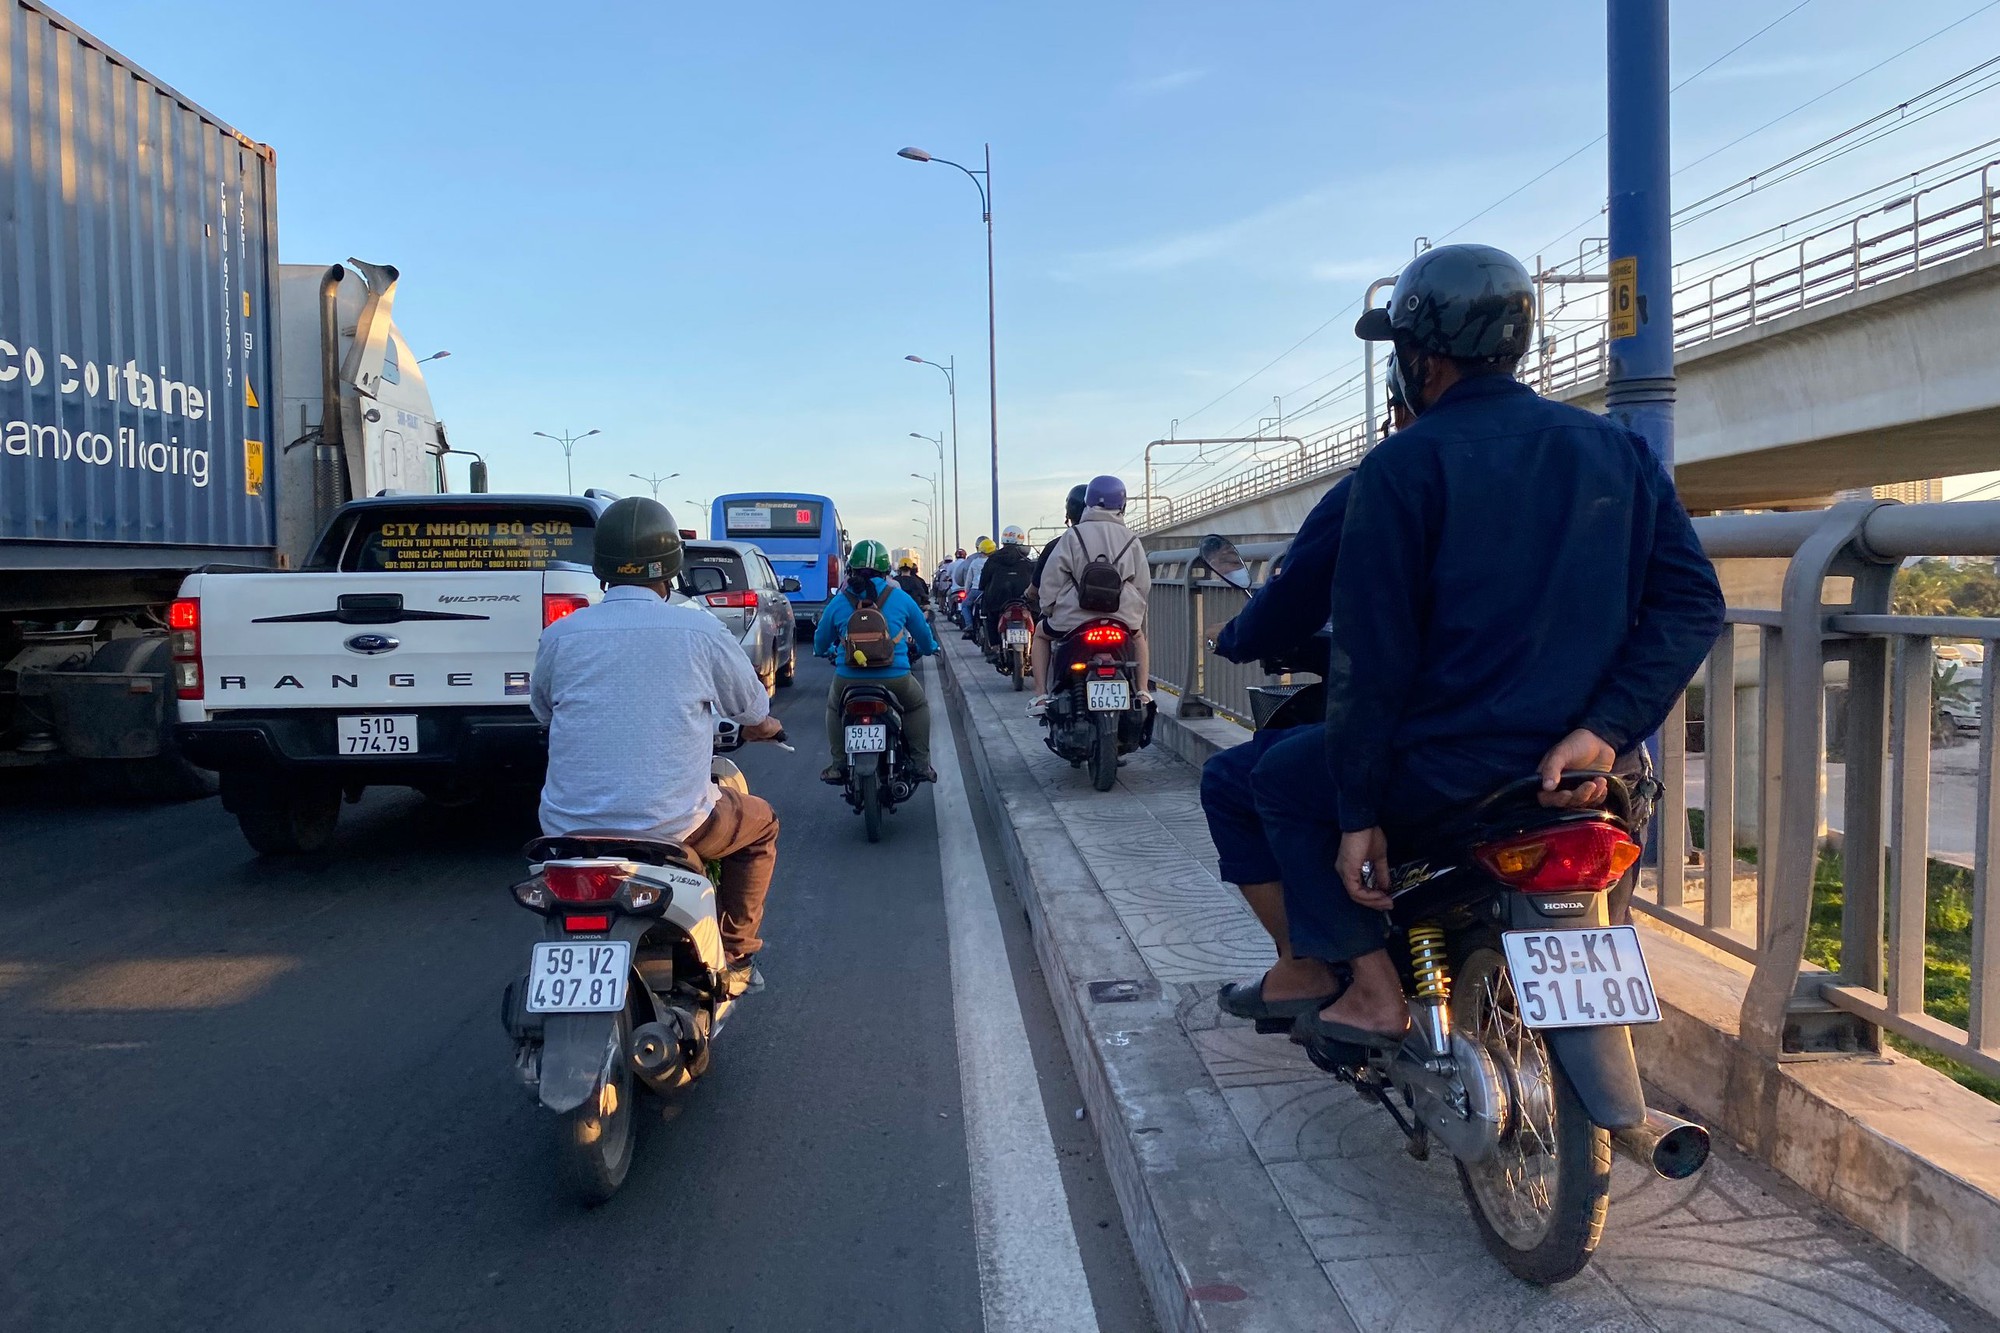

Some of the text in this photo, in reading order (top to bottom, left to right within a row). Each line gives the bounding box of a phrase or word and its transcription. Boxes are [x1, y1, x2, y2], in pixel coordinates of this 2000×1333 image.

[797, 511, 809, 522] 30
[382, 523, 420, 536] CTY
[426, 520, 490, 536] NHÔM
[415, 538, 431, 547] THU
[432, 538, 451, 547] MUA
[398, 550, 420, 559] CUNG
[438, 594, 521, 604] WILDTRAK
[1093, 683, 1122, 696] 77-C1
[1090, 696, 1127, 708] 664.57
[360, 718, 395, 734] 51D
[851, 726, 880, 739] 59-L2
[346, 735, 410, 753] 774.79
[669, 873, 703, 888] VISION
[1543, 902, 1585, 910] HONDA
[546, 947, 615, 975] 59-V2
[1523, 933, 1622, 976] 59-K1
[533, 978, 618, 1007] 497.81
[1522, 976, 1651, 1021] 514.80
